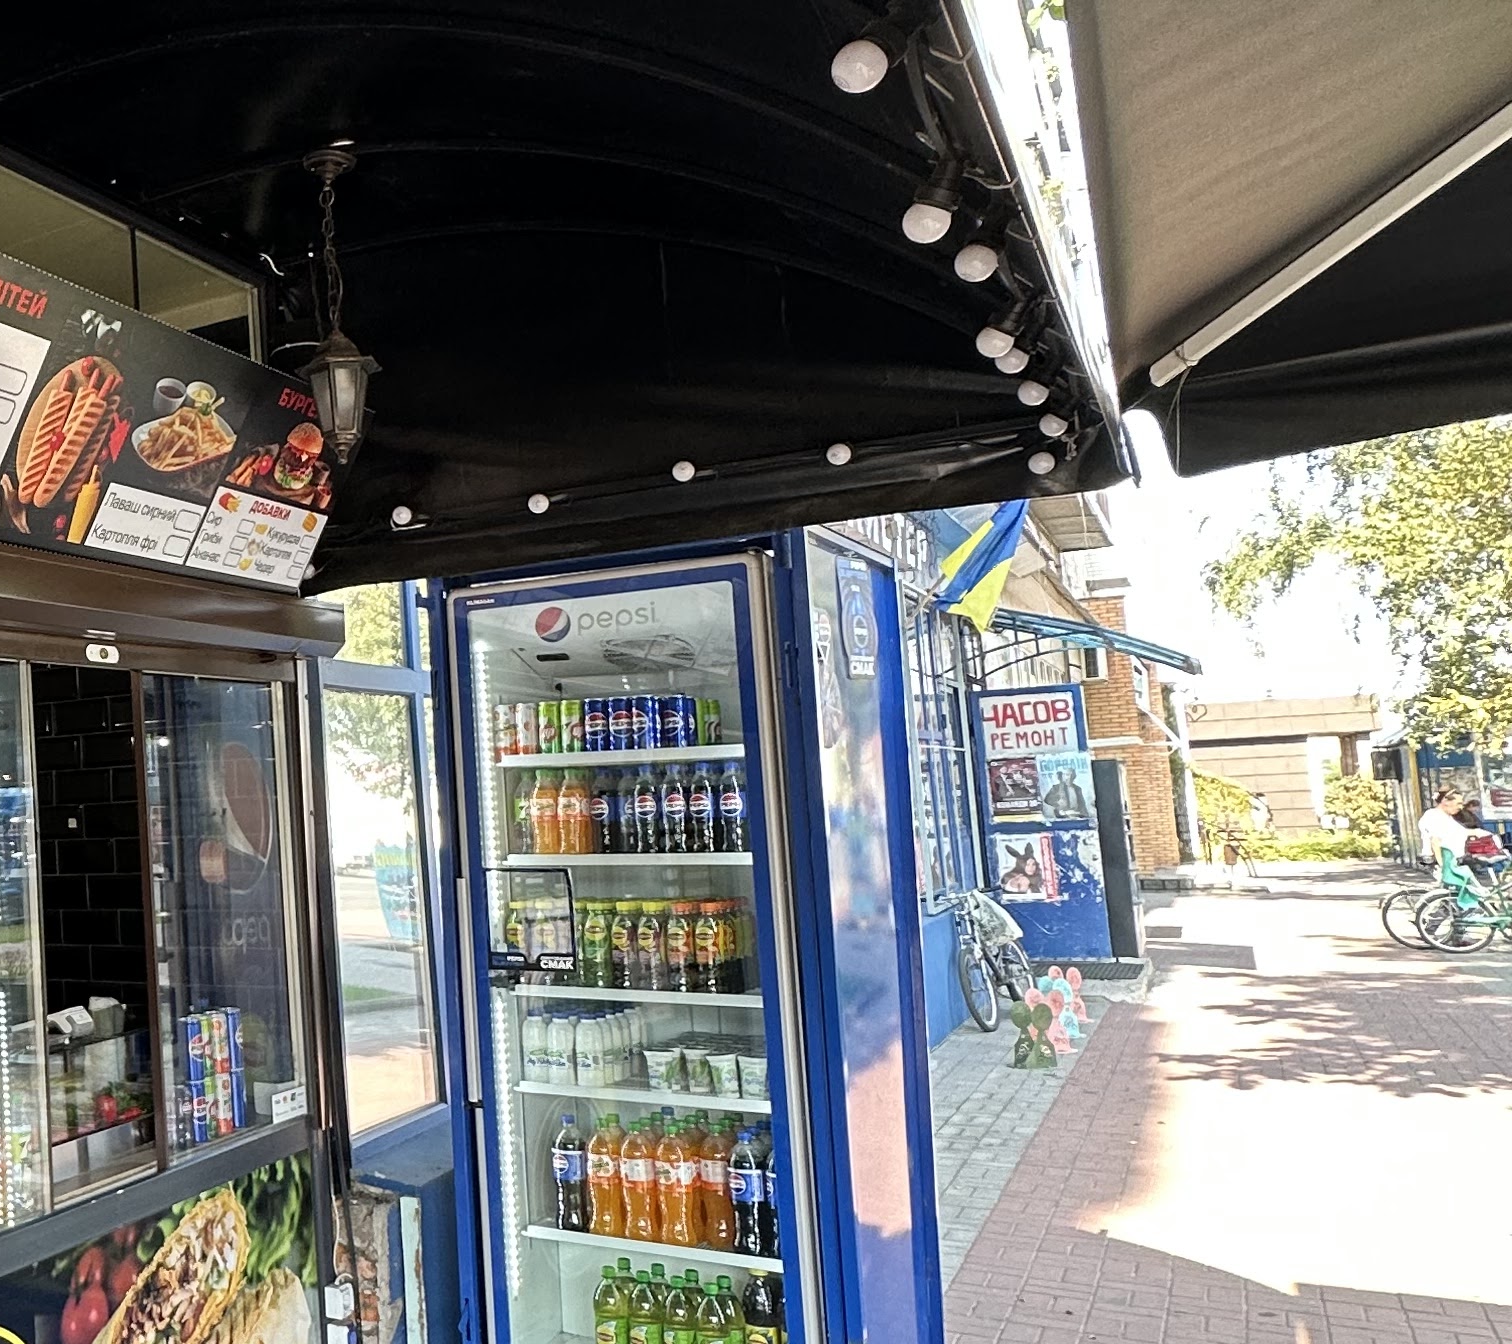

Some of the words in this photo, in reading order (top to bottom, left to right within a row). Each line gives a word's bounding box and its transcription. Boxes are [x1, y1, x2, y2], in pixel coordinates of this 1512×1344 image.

[278, 388, 317, 417] БУРГЕ
[249, 501, 291, 520] ДОБАВКИ
[91, 524, 140, 548] Картопля
[578, 602, 657, 636] pepsi
[983, 699, 1071, 729] ЧАСОВ
[991, 727, 1068, 750] РЕМОНТ
